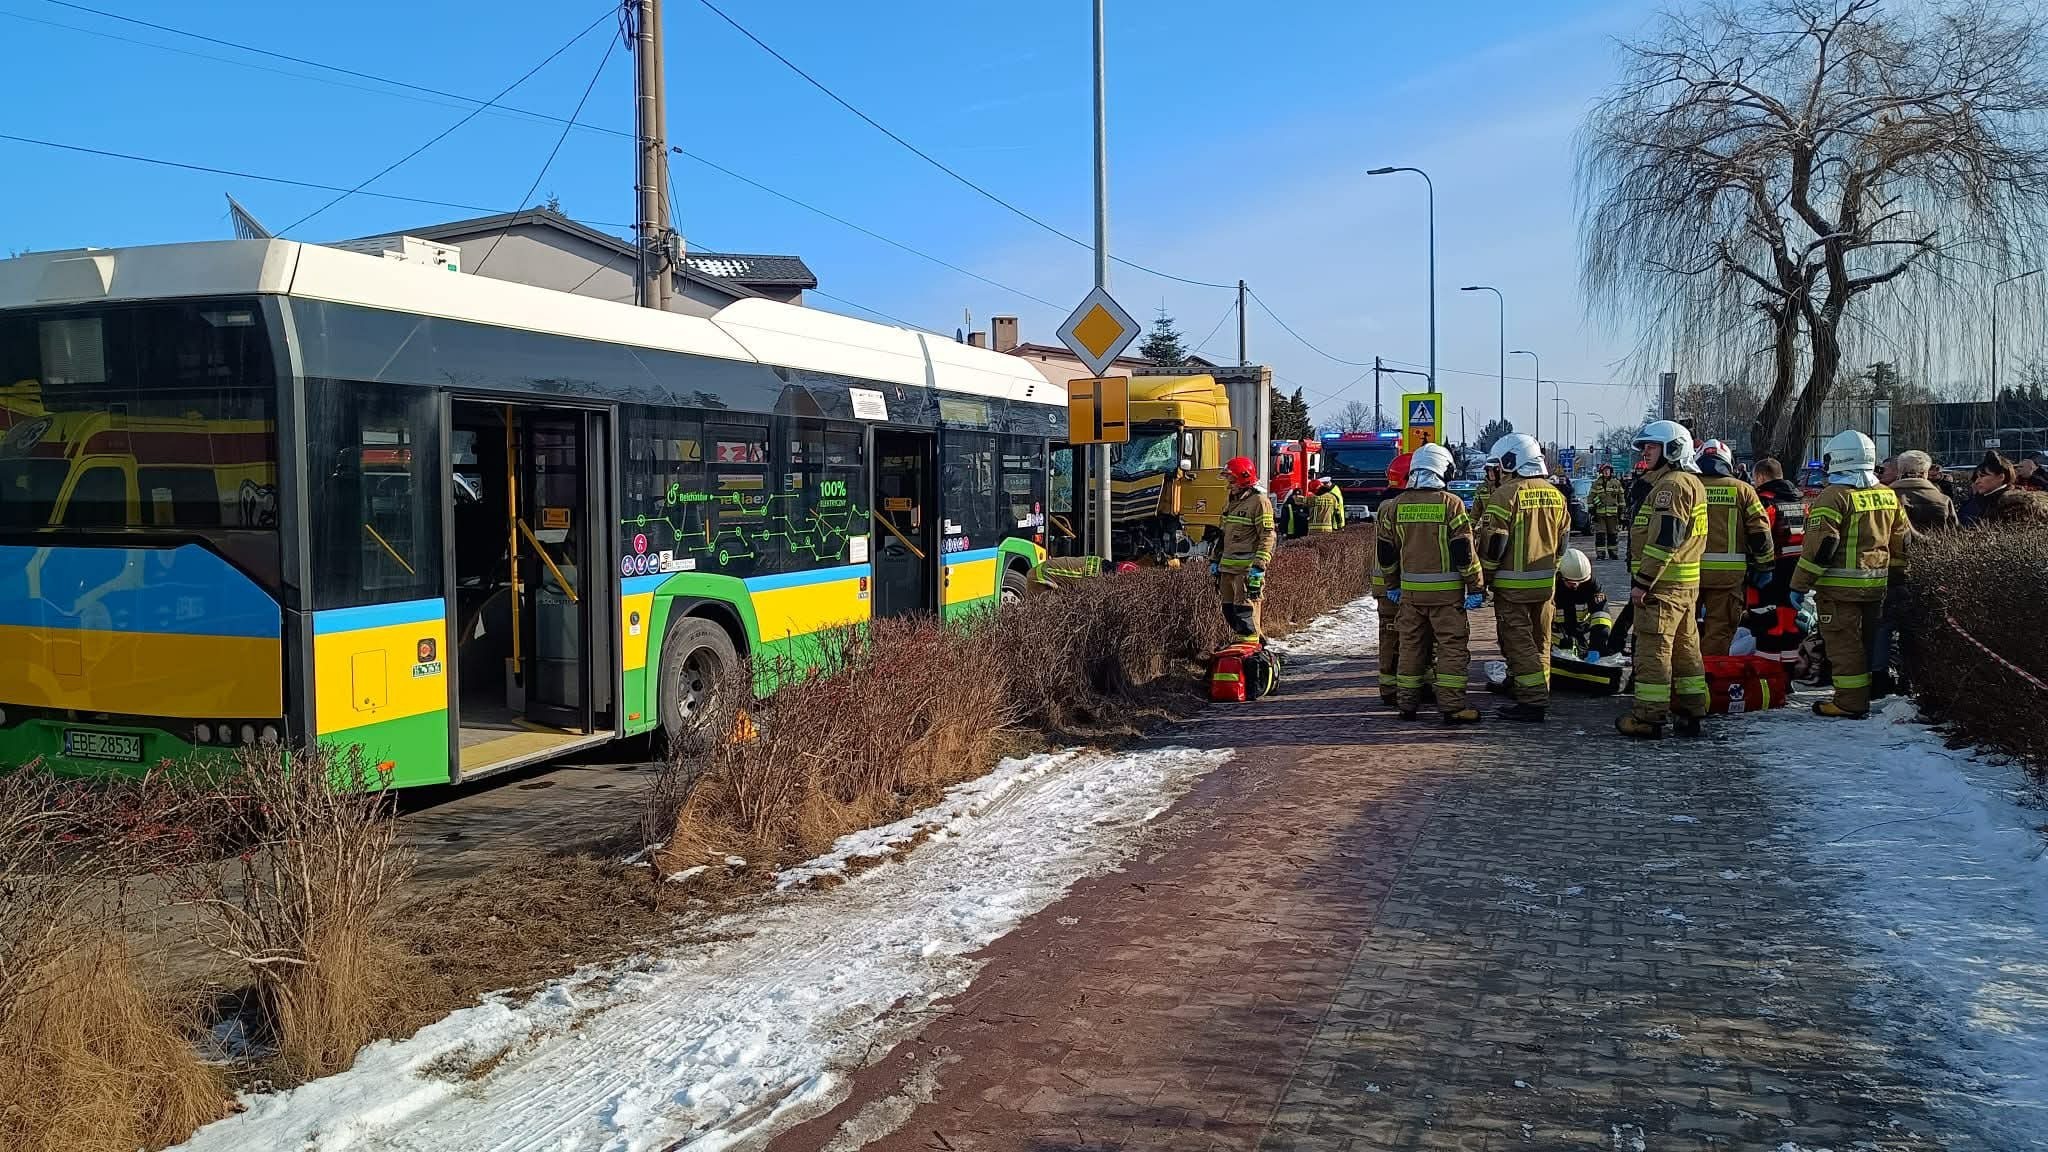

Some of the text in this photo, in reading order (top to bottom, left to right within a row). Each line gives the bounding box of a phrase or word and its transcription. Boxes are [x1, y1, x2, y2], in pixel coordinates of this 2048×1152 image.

[820, 481, 846, 496] 100%
[72, 733, 139, 755] EBE 28534
